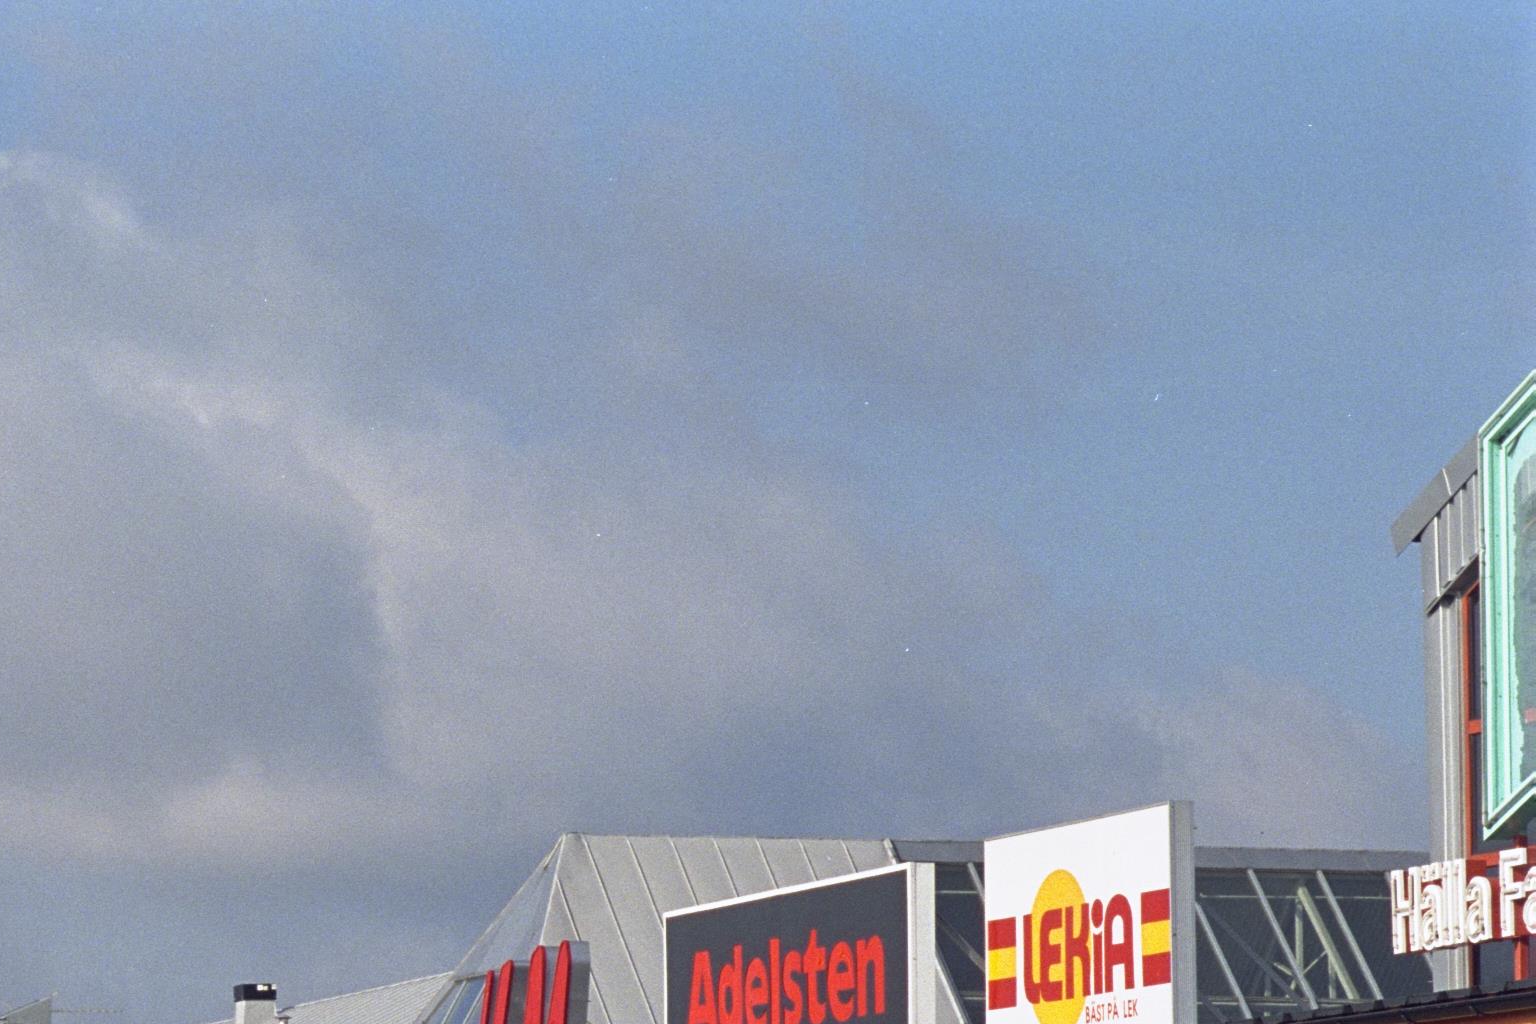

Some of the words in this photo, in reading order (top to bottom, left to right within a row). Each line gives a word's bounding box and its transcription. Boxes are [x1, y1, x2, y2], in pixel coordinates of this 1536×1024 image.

[1390, 858, 1493, 955] Hälla
[1085, 1002, 1105, 1024] BÄST
[1107, 995, 1119, 1020] PÅ
[1123, 998, 1139, 1019] LEK
